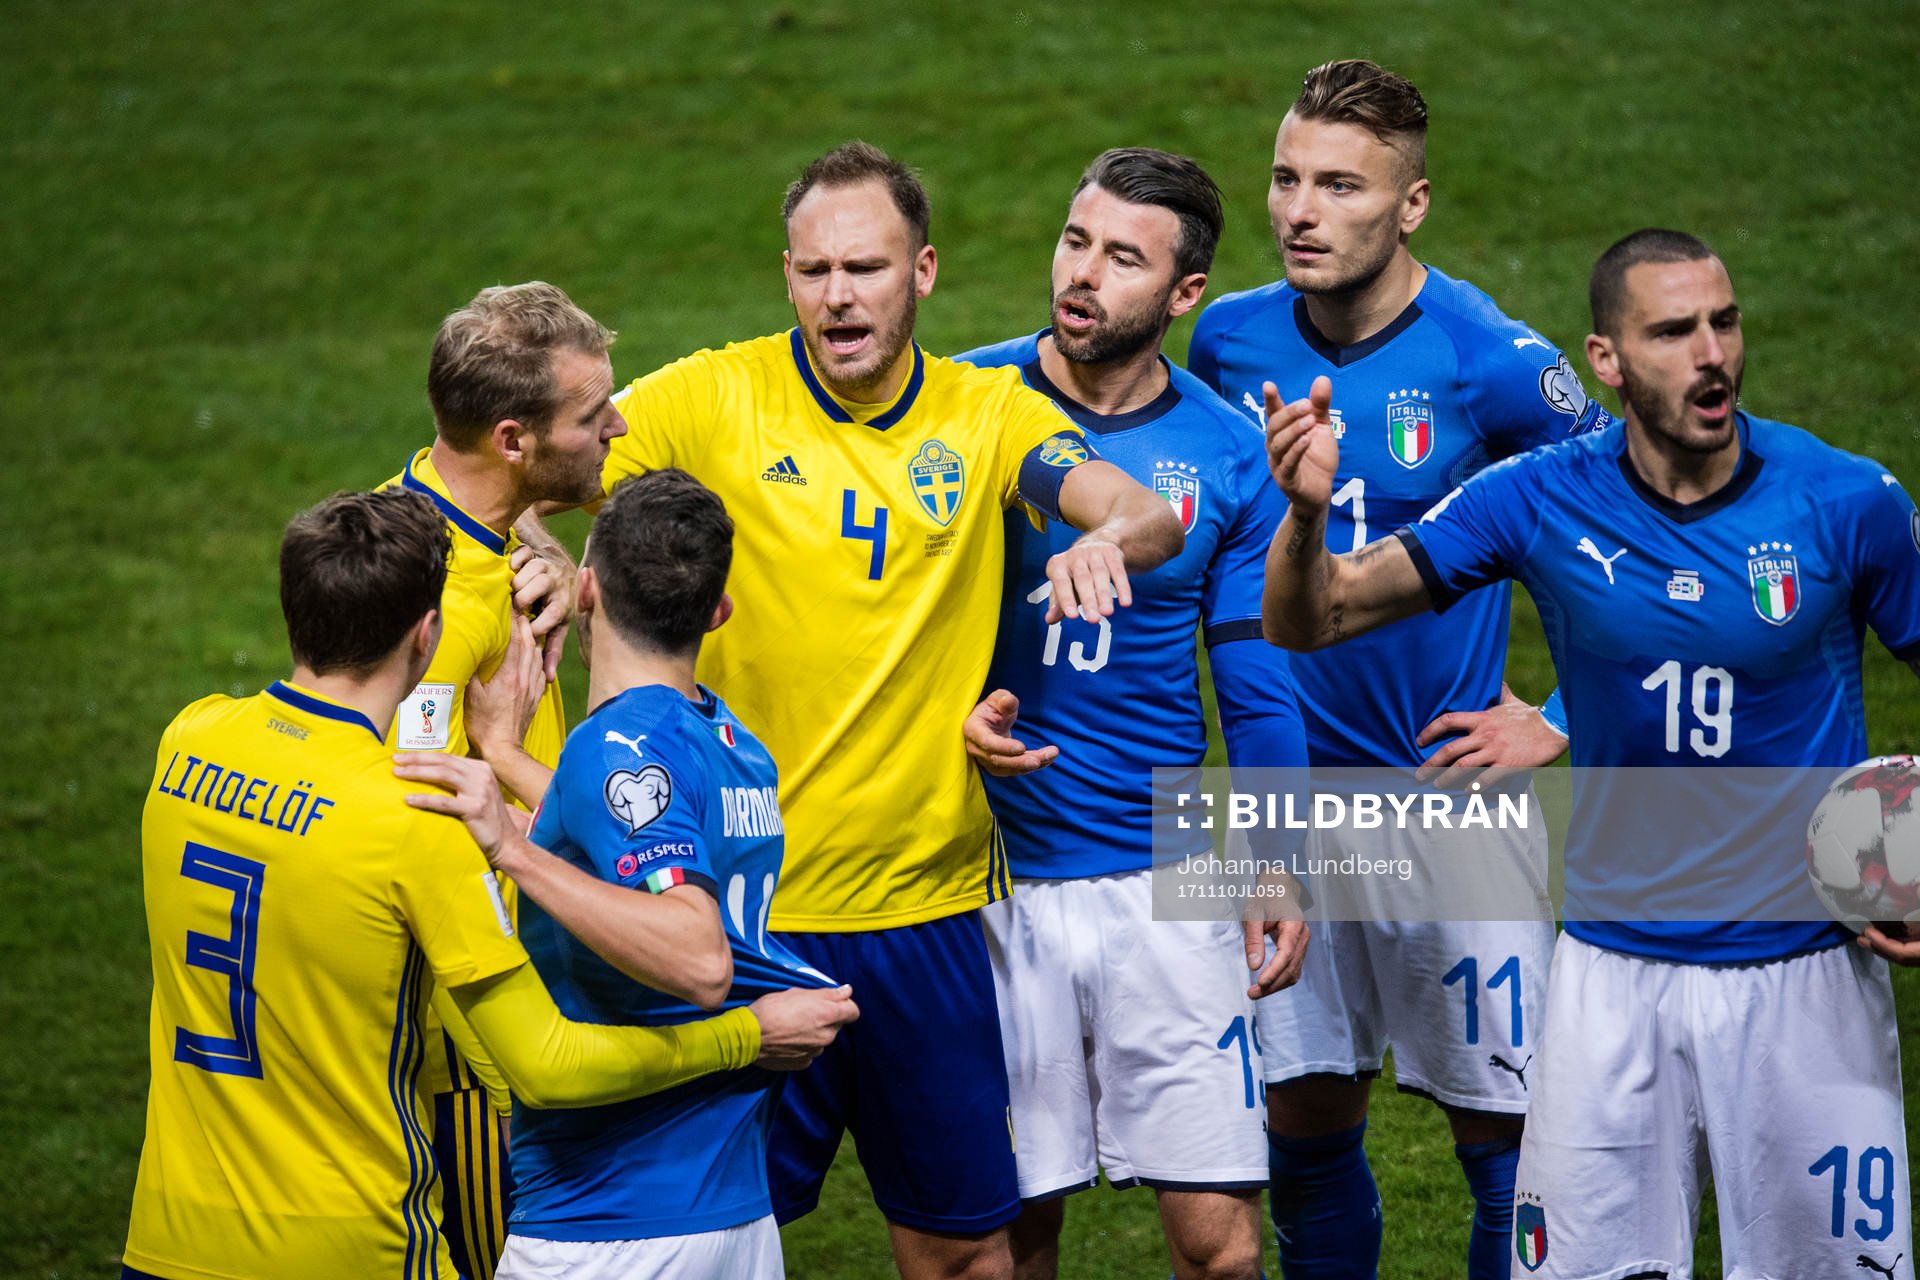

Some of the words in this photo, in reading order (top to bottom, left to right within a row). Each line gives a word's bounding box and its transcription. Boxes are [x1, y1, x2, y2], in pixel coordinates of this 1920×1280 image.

[1391, 406, 1429, 417] ITALIA
[761, 472, 807, 486] adidas
[918, 463, 954, 474] SVERIGE
[1157, 477, 1194, 491] ITALIA
[841, 488, 888, 581] 4
[1331, 477, 1367, 552] 1
[1753, 559, 1793, 574] ITALIA
[413, 687, 452, 695] ALIFIERS
[1642, 660, 1734, 758] 19
[266, 718, 312, 741] SVERIGE
[158, 751, 335, 837] LINDELÖF
[720, 786, 785, 838] DARMIA
[637, 843, 695, 865] RESPECT
[173, 840, 266, 1080] 3
[1441, 956, 1523, 1048] 11
[1217, 1015, 1267, 1109] 1
[1808, 1145, 1895, 1242] 19
